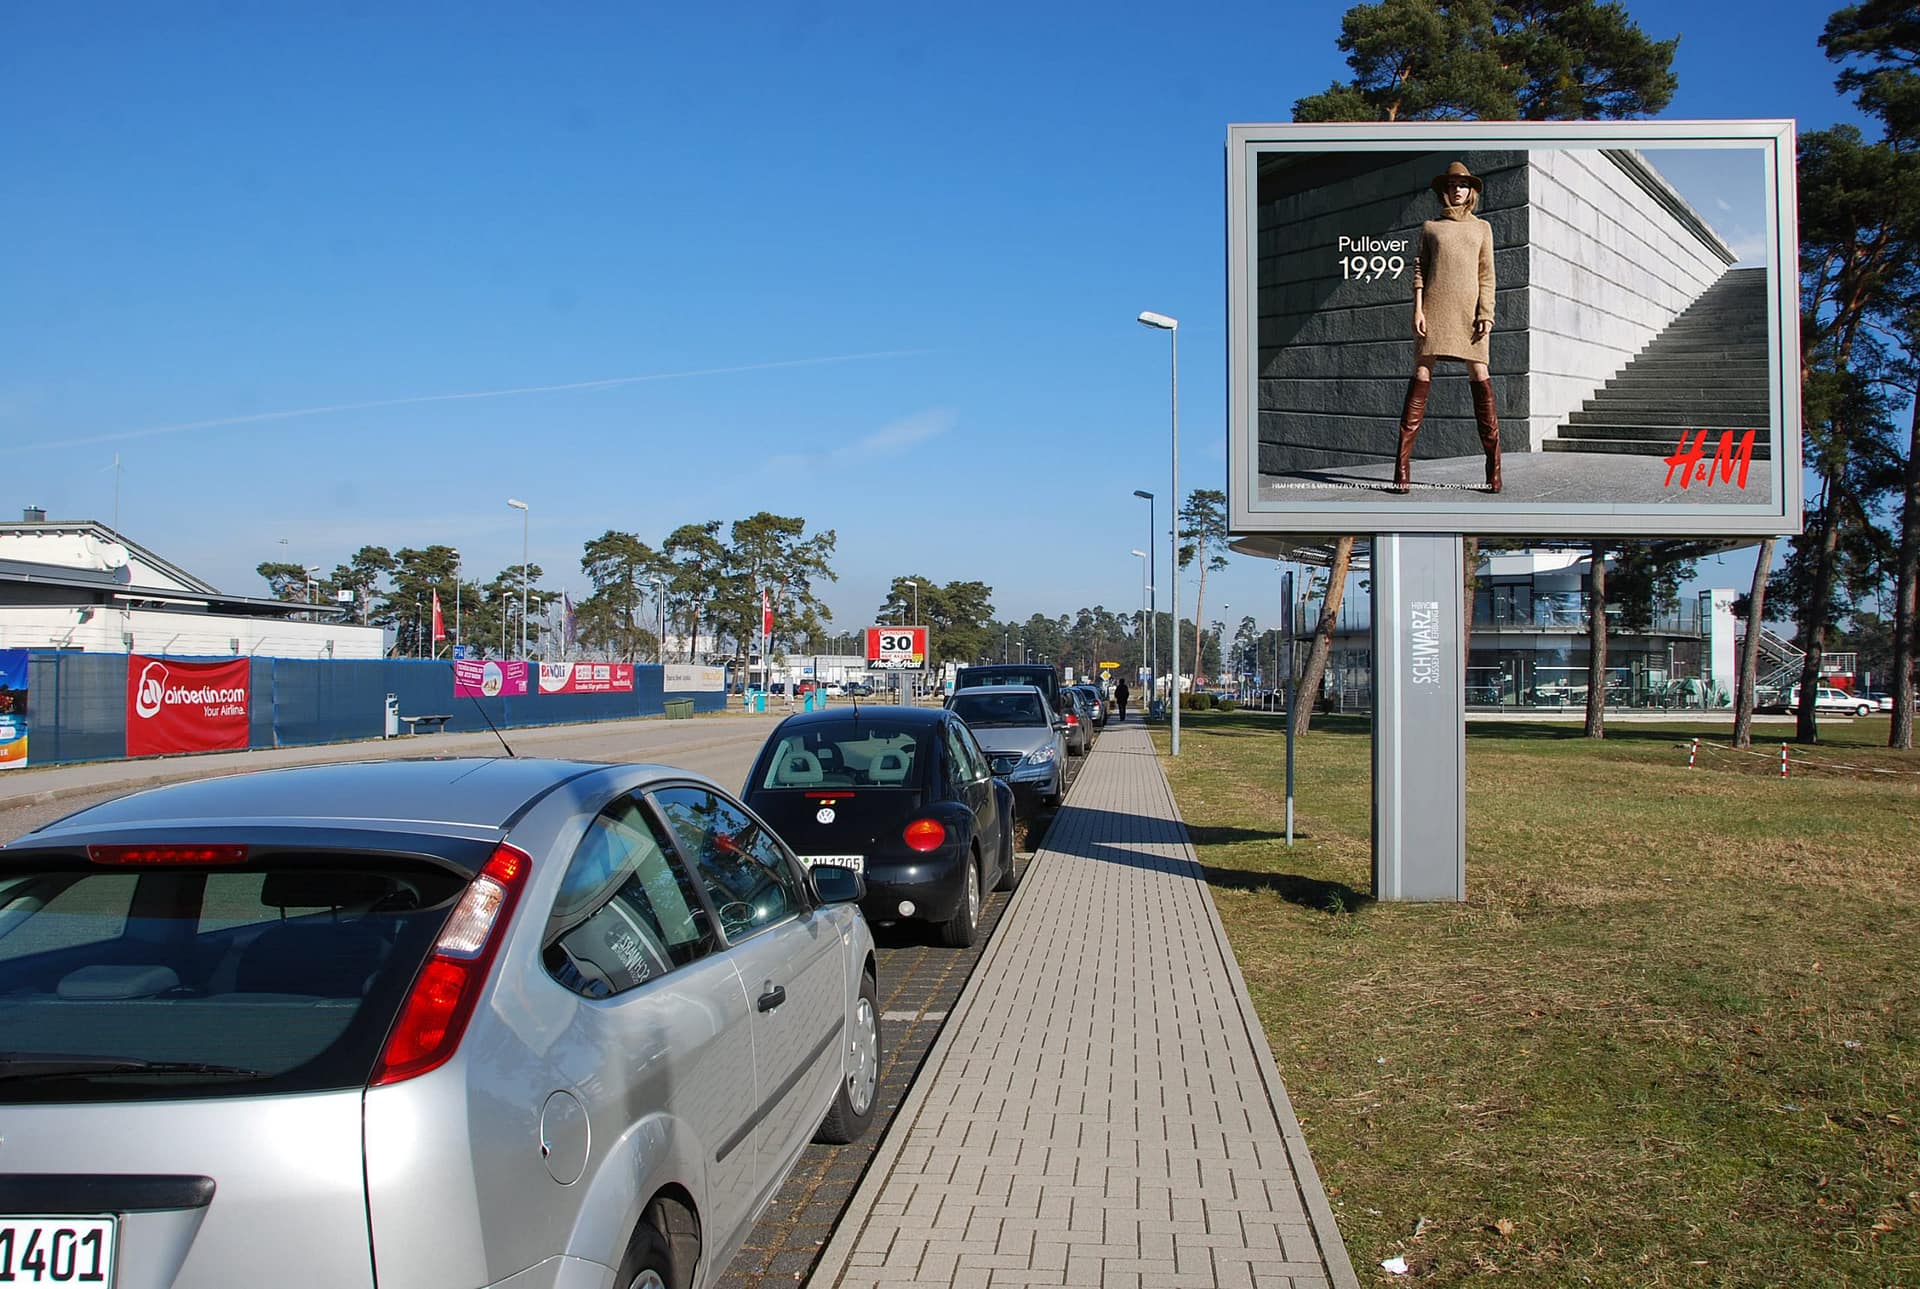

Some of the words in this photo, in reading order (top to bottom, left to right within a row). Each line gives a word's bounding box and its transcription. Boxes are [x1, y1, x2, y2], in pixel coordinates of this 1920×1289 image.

[1339, 236, 1408, 252] Pullover
[1339, 256, 1404, 283] 19,99
[1664, 428, 1756, 490] H&M
[881, 636, 911, 650] 30
[1412, 610, 1439, 684] SCHWARZ
[165, 685, 245, 704] airberlin.com
[204, 705, 219, 716] Your
[0, 1228, 104, 1282] 1401
